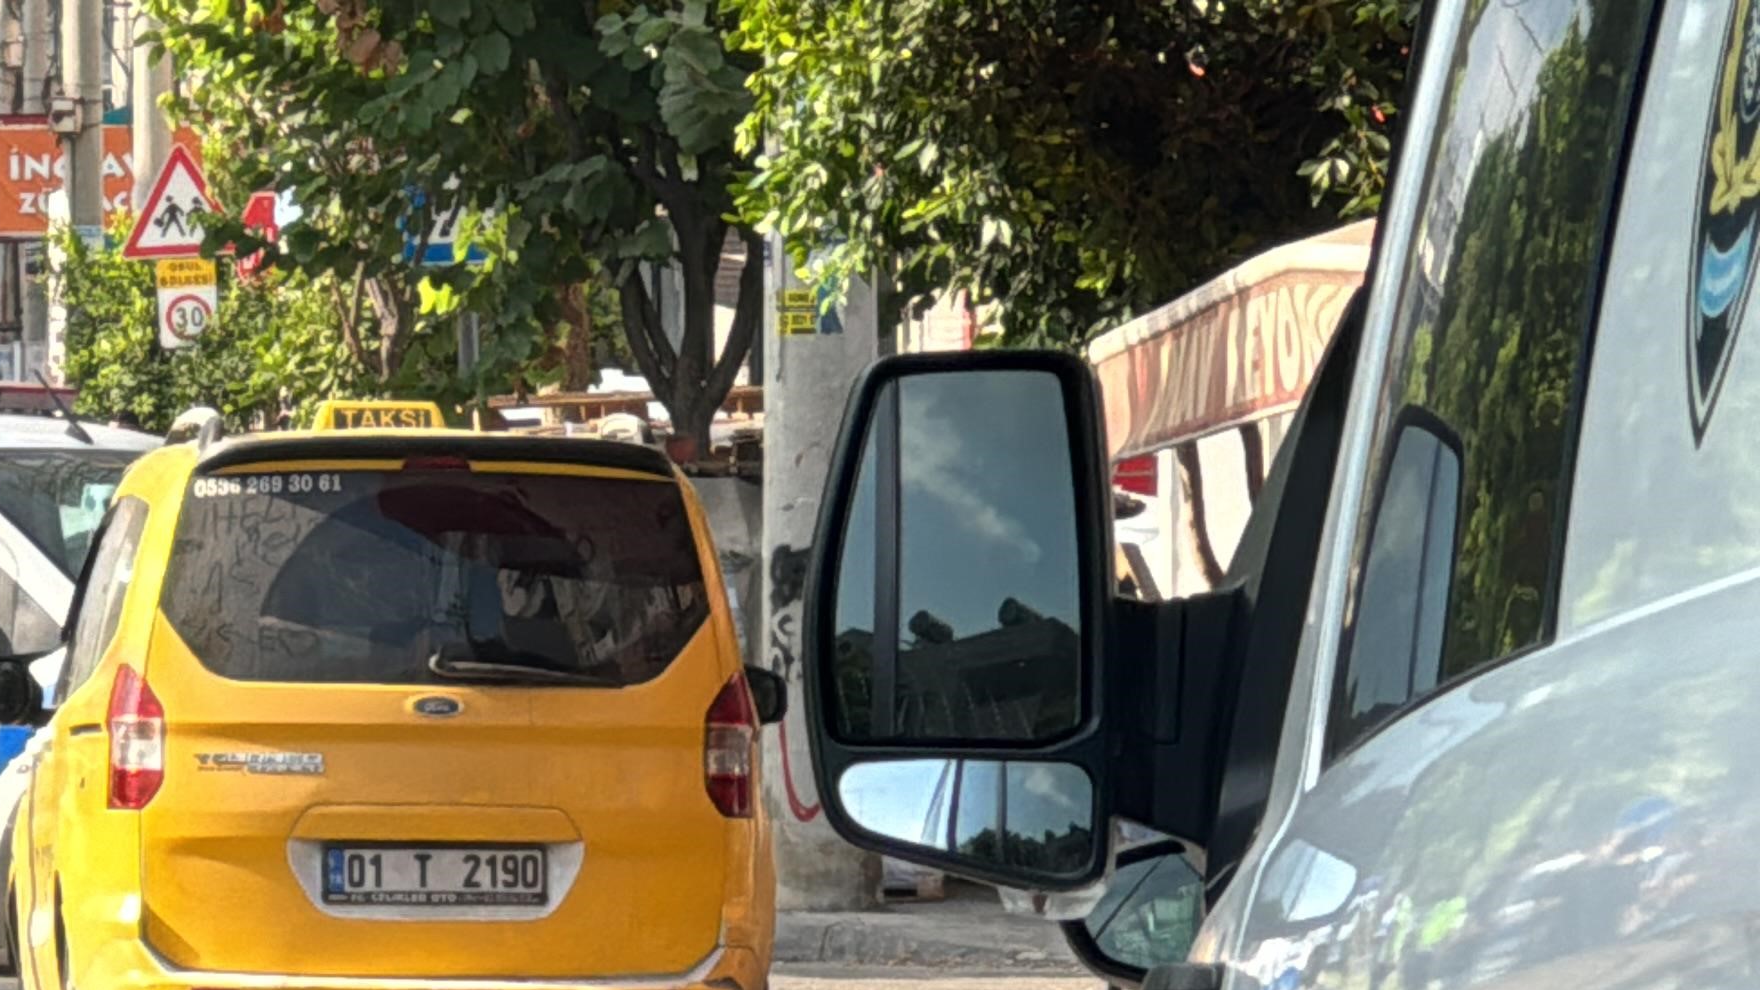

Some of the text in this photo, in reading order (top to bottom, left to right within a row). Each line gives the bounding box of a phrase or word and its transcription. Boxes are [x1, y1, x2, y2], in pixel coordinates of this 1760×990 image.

[175, 306, 203, 329] 30
[246, 475, 282, 494] 269
[289, 474, 313, 493] 30
[319, 473, 342, 492] 61
[347, 853, 539, 889] 01 T 2190
